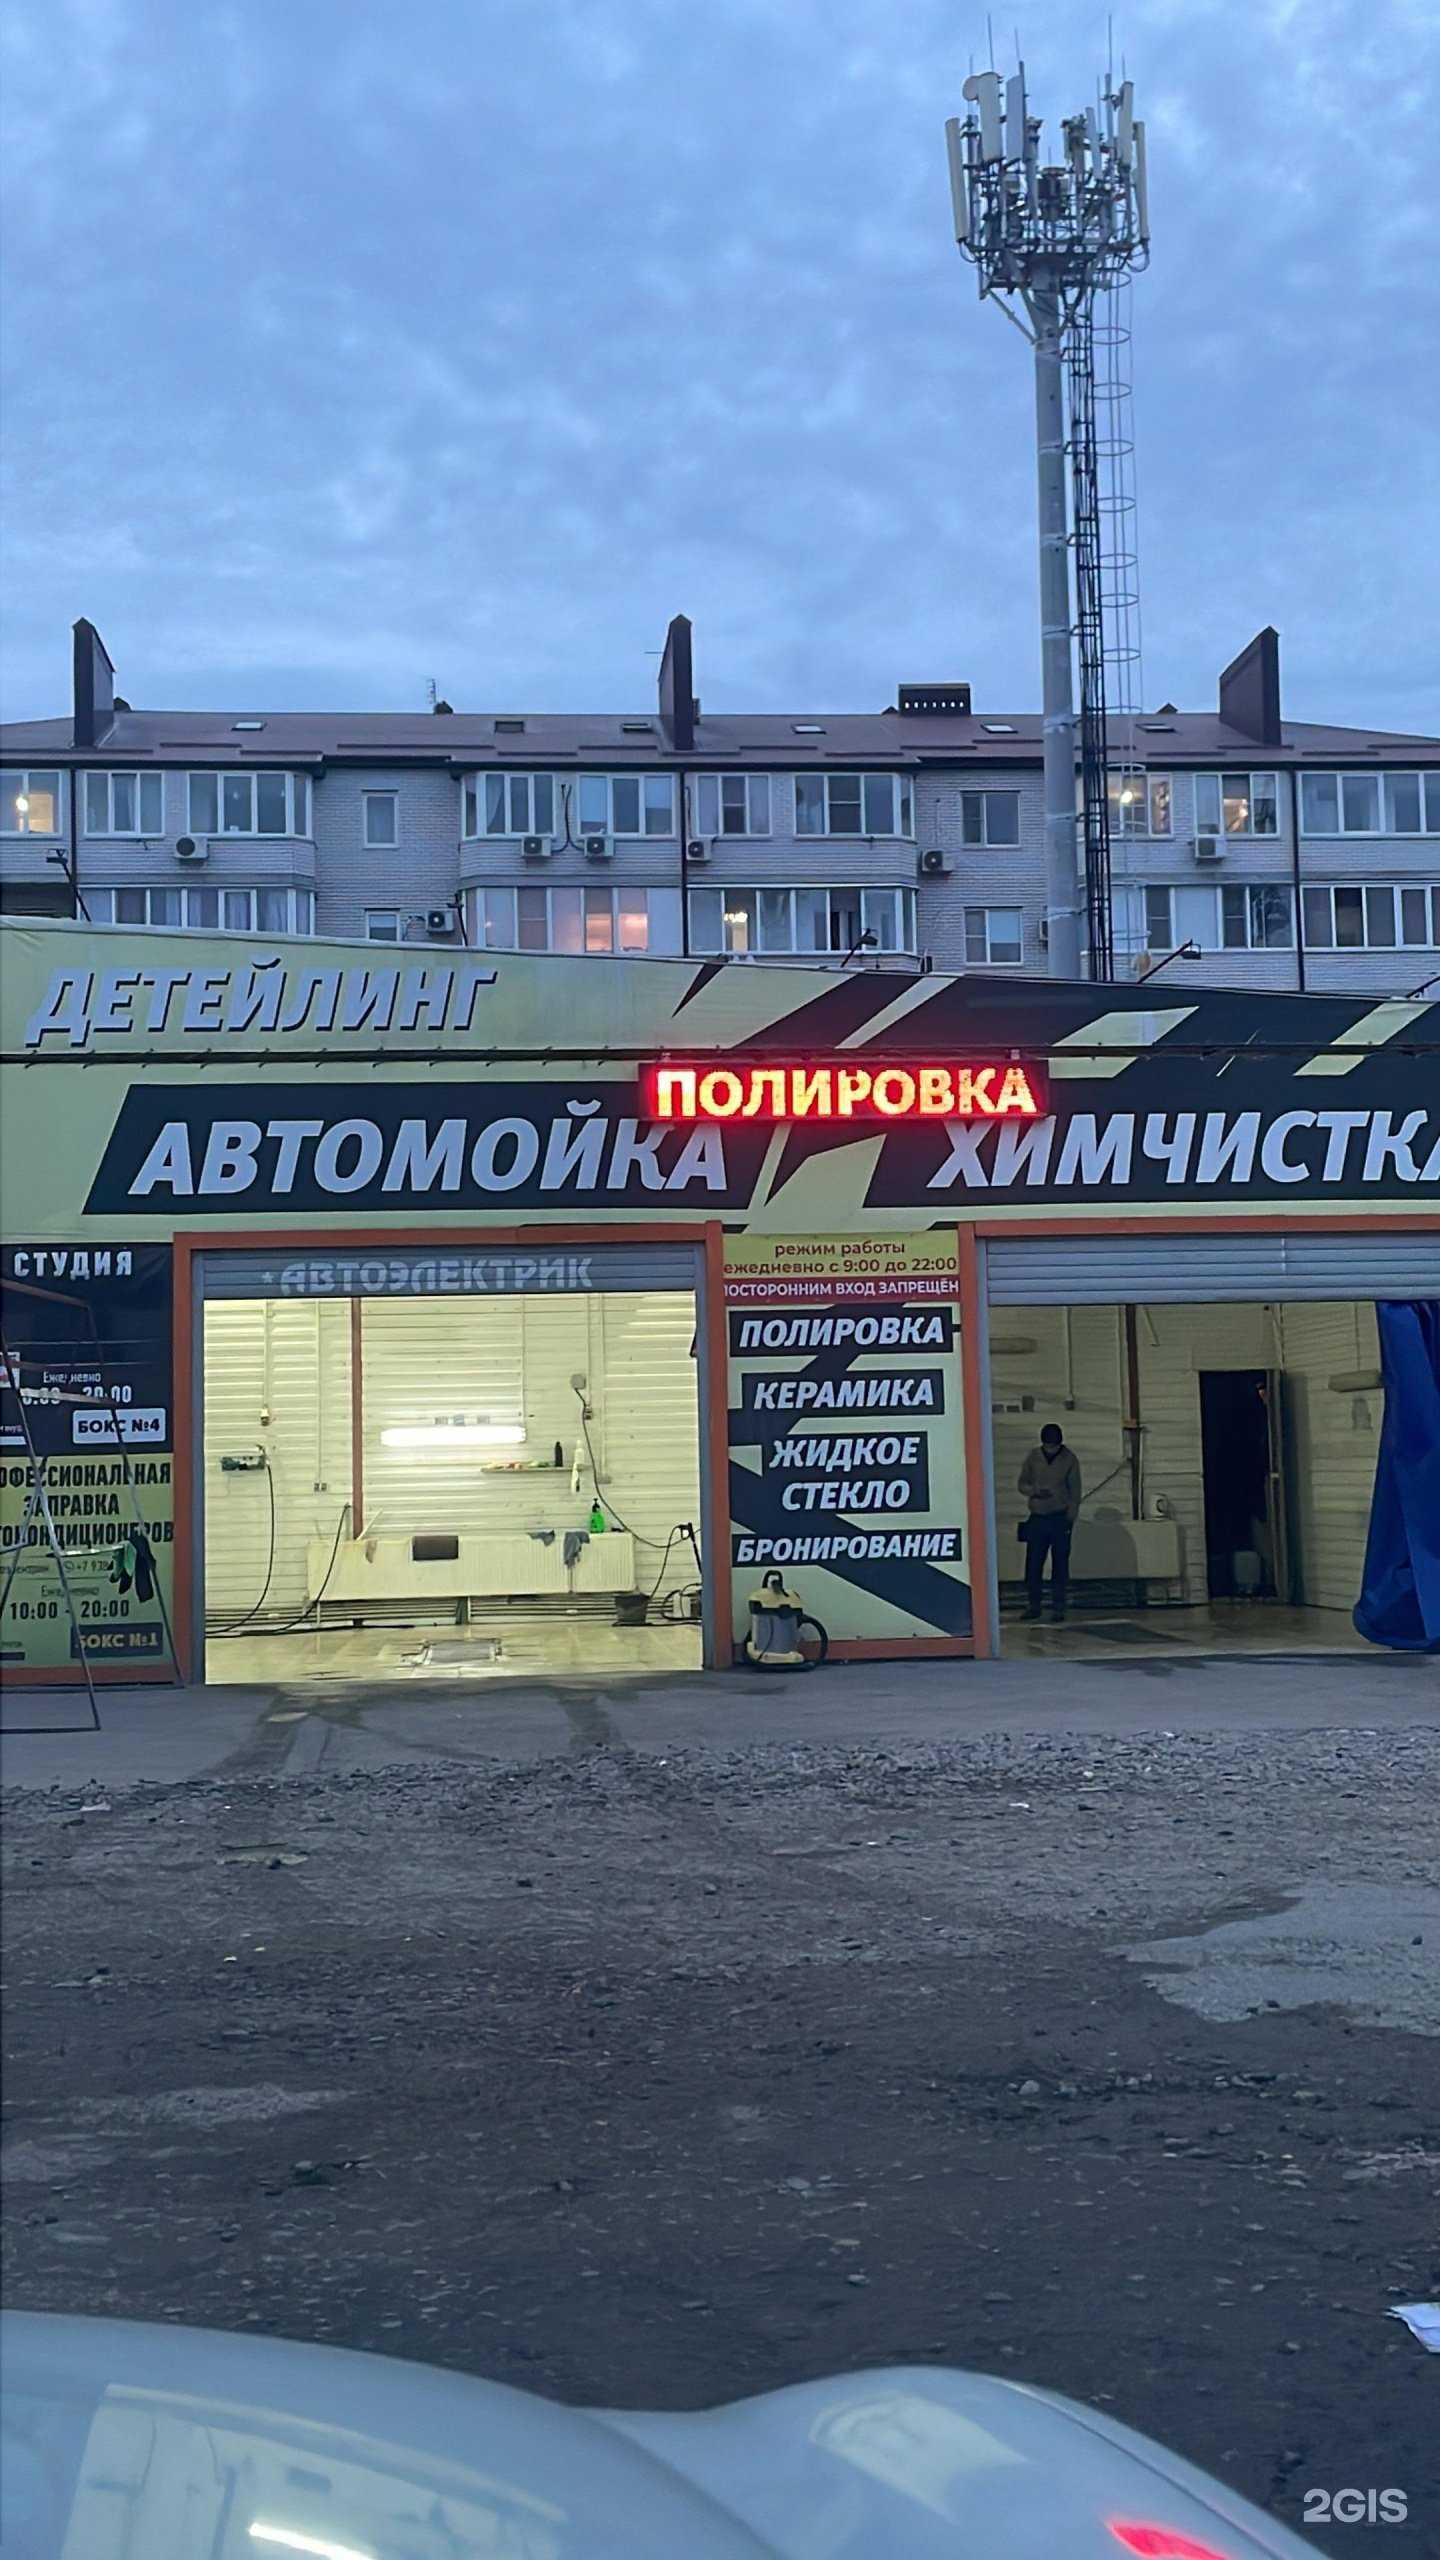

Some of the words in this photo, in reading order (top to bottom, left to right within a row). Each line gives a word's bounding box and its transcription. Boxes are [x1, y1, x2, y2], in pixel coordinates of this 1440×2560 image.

[25, 955, 498, 1047] ДЕТЕЙЛИНГ
[657, 1068, 1037, 1118] ПОЛИРОВКА
[128, 1099, 727, 1195] АВТОМОЙКА
[775, 1244, 836, 1258] режим
[841, 1240, 905, 1257] работы
[14, 1251, 132, 1280] СТУДИЯ
[280, 1257, 593, 1296] АВТОЭЛЕКТРИК
[723, 1262, 825, 1275] ежедневно
[829, 1262, 839, 1272] с
[843, 1260, 880, 1272] 9:00
[885, 1261, 907, 1272] до
[912, 1257, 957, 1271] 22:00
[836, 1282, 876, 1297] ВХОД
[879, 1278, 959, 1295] ЗАПРЕЩЁН
[739, 1317, 944, 1348] ПОЛИРОВКА
[753, 1379, 934, 1410] КЕРАМИКА
[78, 1420, 127, 1433] БОКС
[131, 1418, 160, 1432] №4
[769, 1436, 920, 1472] ЖИДКОЕ
[24, 1493, 120, 1516] ЗАПРАВКА
[782, 1480, 910, 1510] СТЕКЛО
[0, 1521, 174, 1549] ОКОНДИЦИОНЕРОВ
[736, 1533, 957, 1562] БРОНИРОВАНИЕ
[10, 1602, 58, 1620] 10:00
[81, 1600, 130, 1618] 20:00
